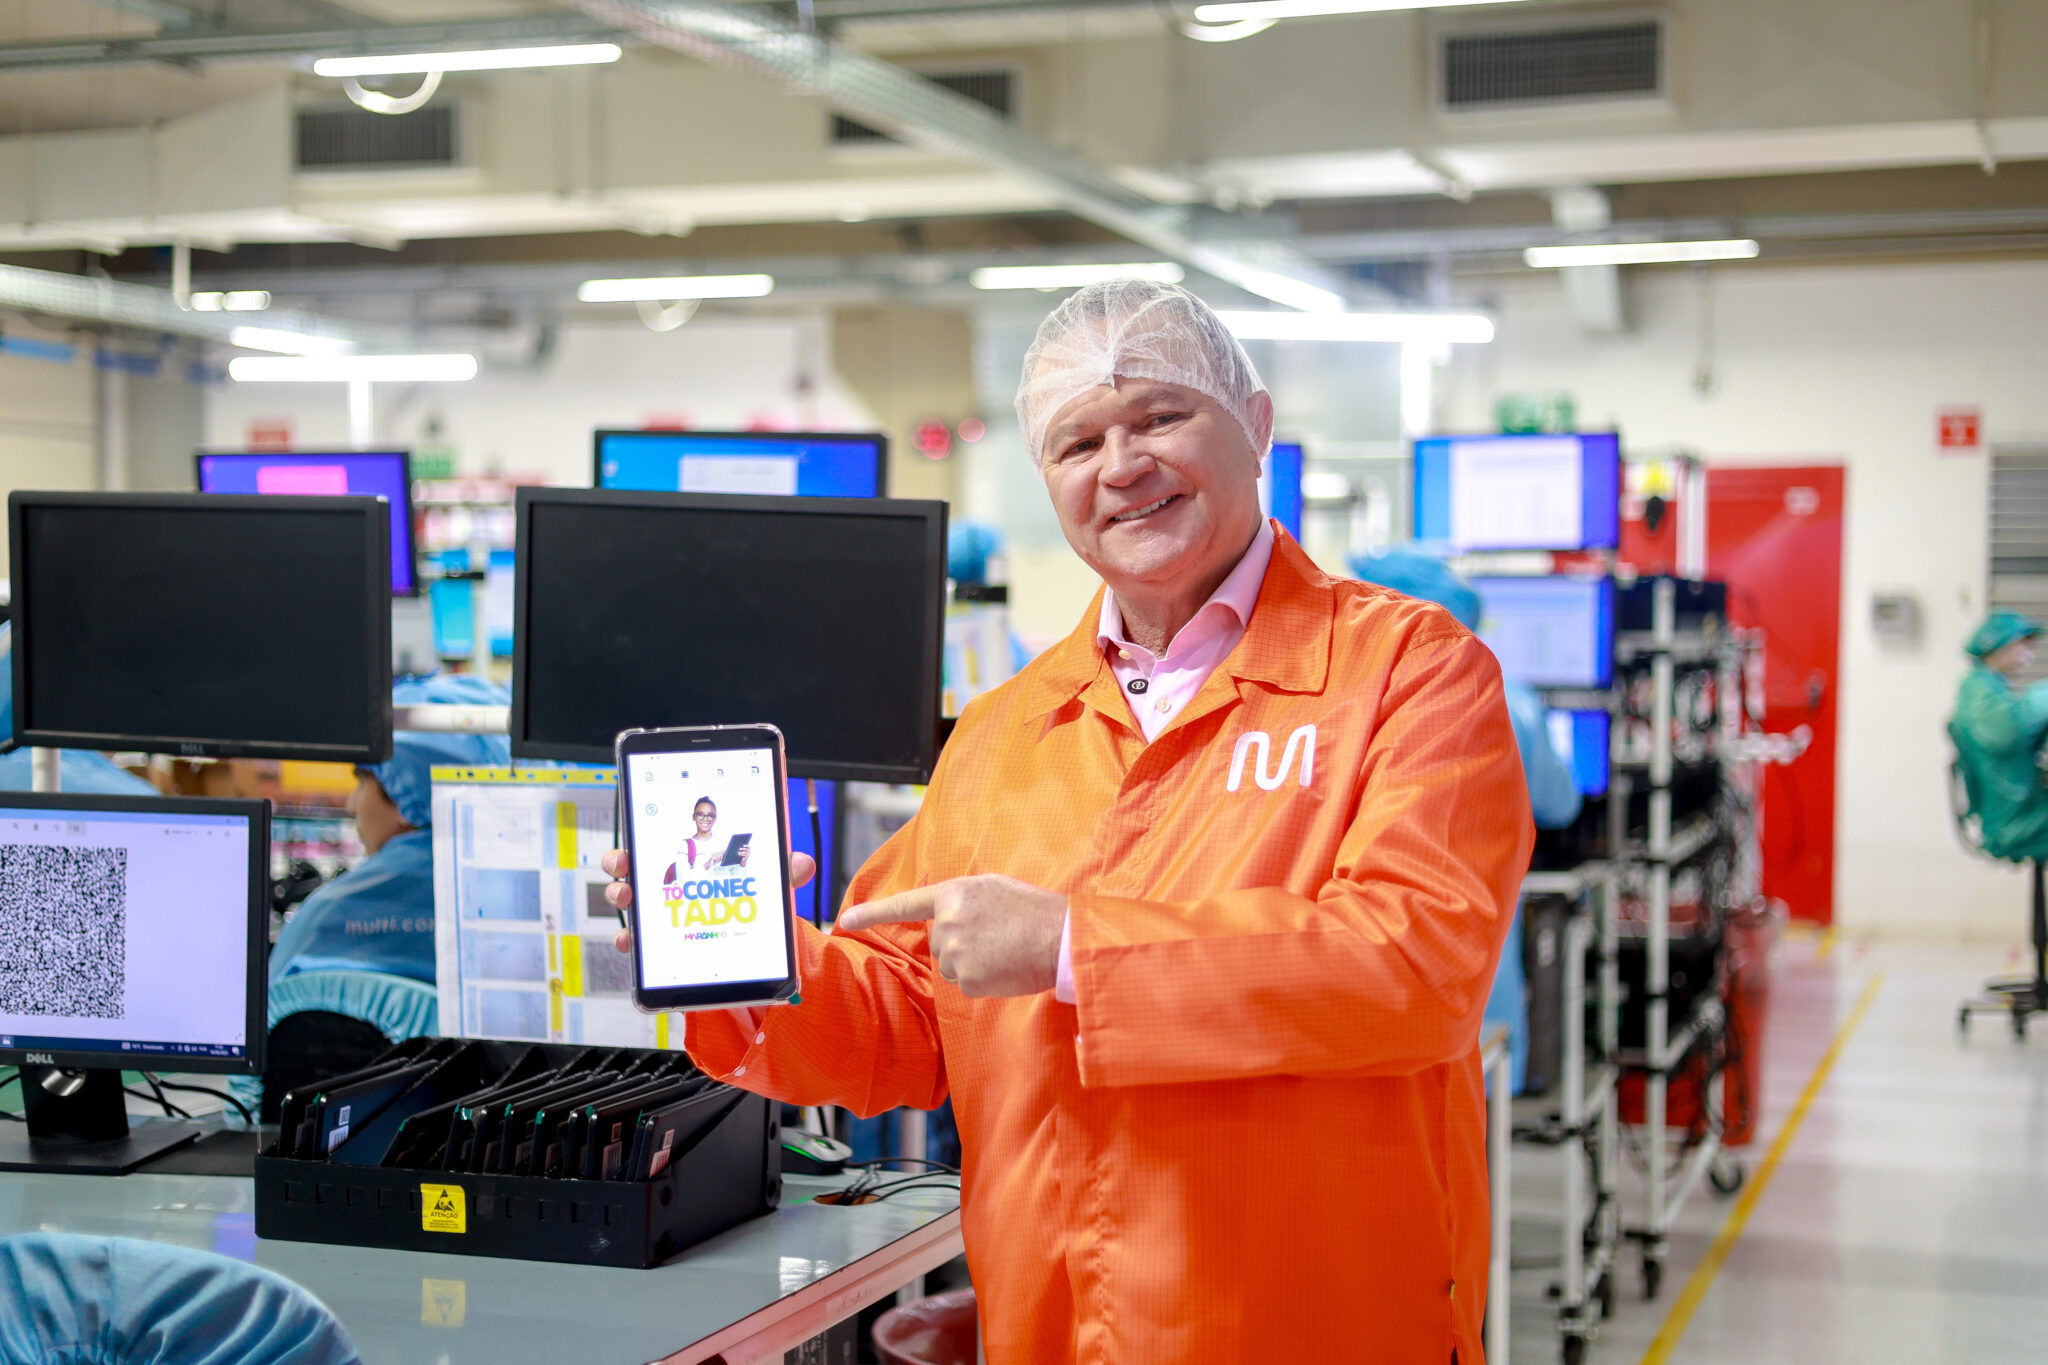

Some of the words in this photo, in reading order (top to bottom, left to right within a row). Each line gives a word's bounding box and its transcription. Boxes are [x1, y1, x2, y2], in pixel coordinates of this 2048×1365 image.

[664, 896, 757, 928] TADO
[26, 1053, 54, 1064] DELL
[431, 1211, 458, 1219] ATENÇÃO
